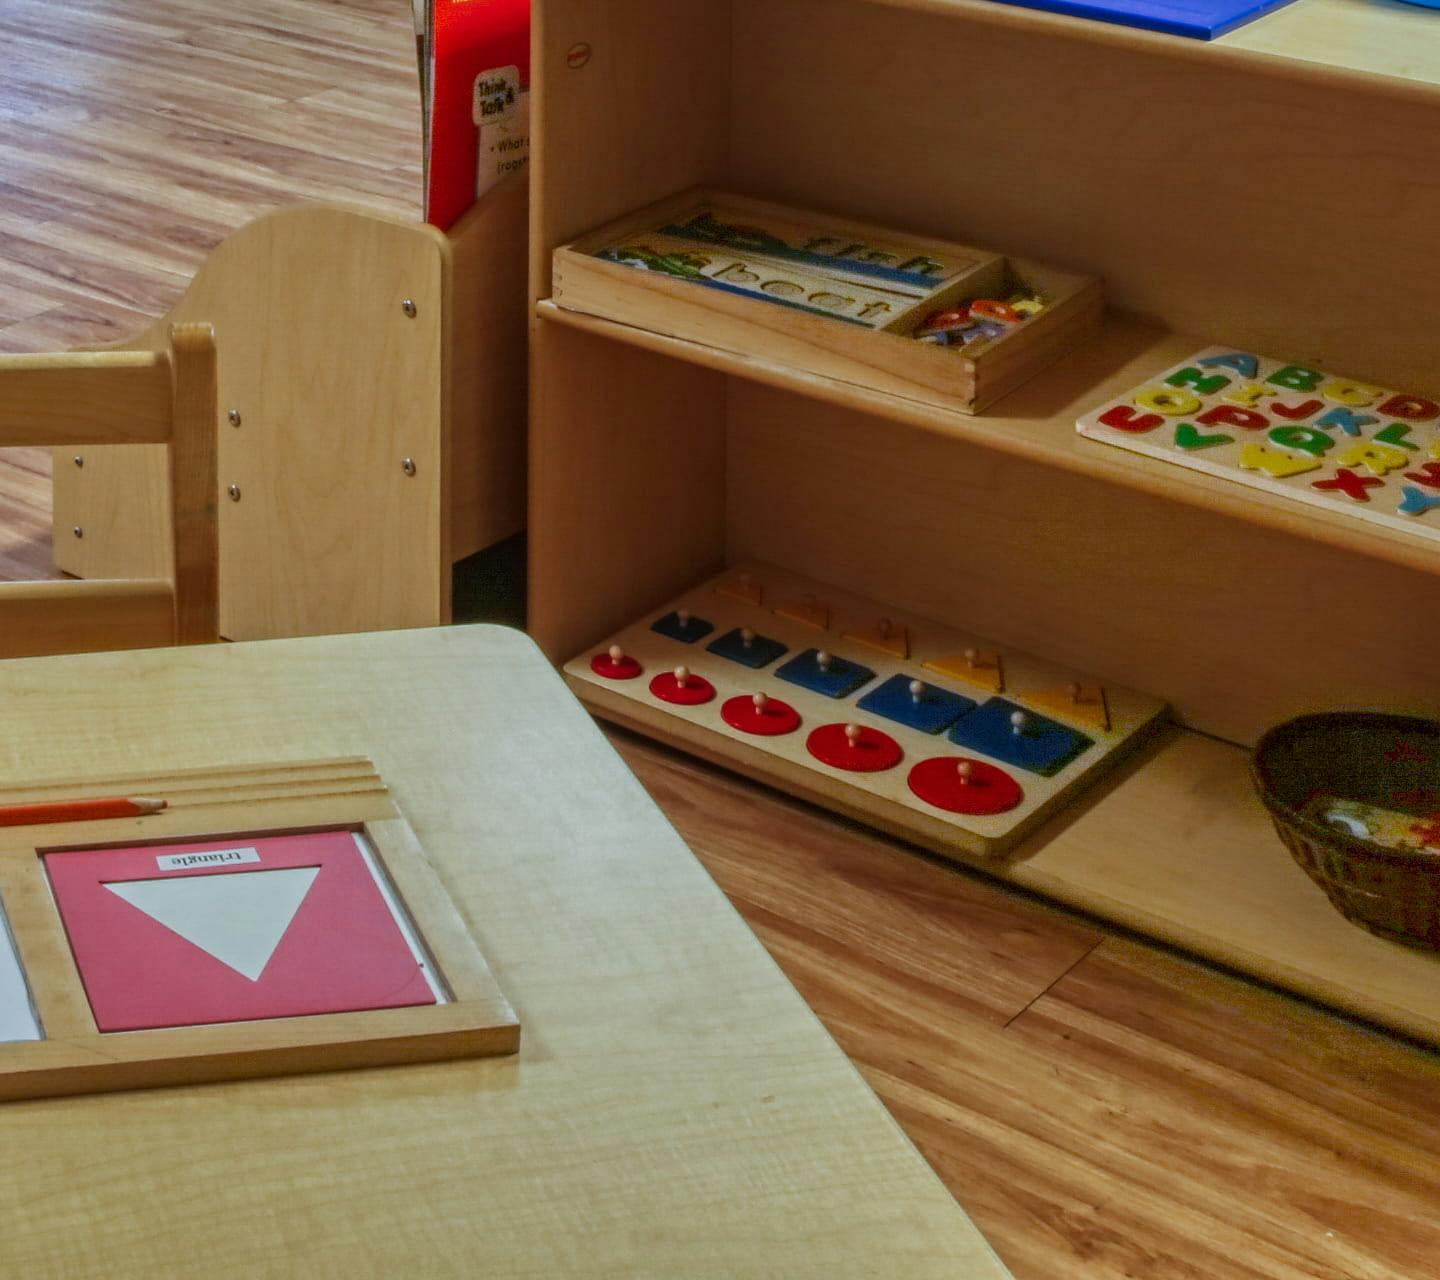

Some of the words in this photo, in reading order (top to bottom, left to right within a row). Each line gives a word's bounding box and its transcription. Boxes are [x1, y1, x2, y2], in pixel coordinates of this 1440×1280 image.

[1196, 352, 1259, 379] A
[1266, 366, 1325, 392] B
[1322, 382, 1383, 407] C
[1134, 389, 1202, 416] O
[1195, 405, 1270, 431] P
[1268, 424, 1336, 458] Q
[1337, 442, 1409, 476] R
[1271, 399, 1324, 421] J
[1312, 407, 1380, 437] K
[1372, 422, 1420, 451] L
[1097, 405, 1165, 433] U
[1175, 423, 1235, 450] V
[1311, 468, 1385, 502] X
[171, 851, 242, 867] triangle
